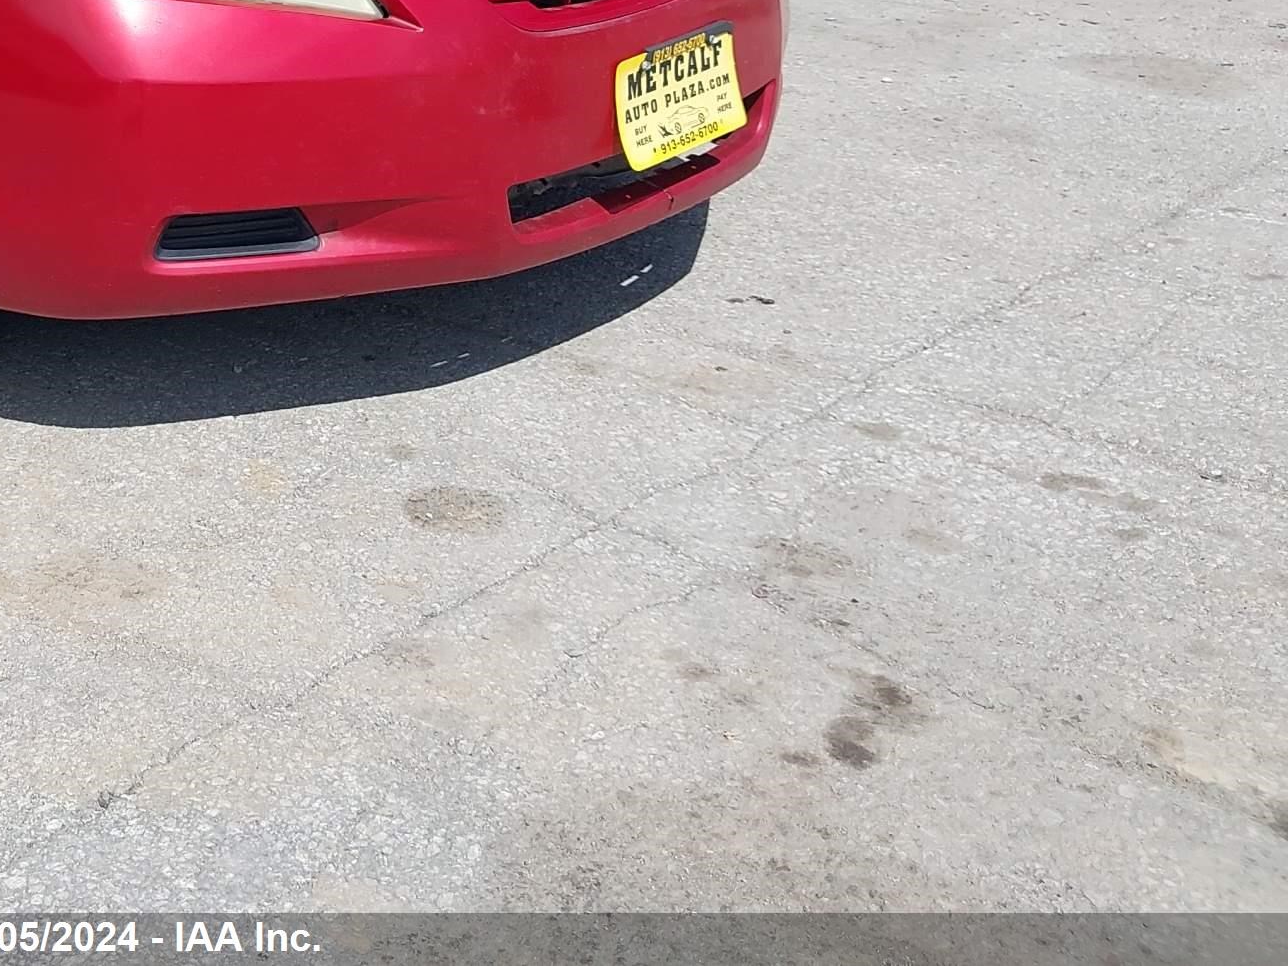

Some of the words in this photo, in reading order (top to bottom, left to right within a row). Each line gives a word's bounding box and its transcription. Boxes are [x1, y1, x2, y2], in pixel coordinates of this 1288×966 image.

[627, 39, 722, 101] METCALF
[625, 98, 658, 124] AUTO
[664, 73, 730, 108] PLAZA.COM
[716, 92, 728, 102] PAY
[717, 101, 732, 114] HERE
[634, 125, 648, 136] BUY
[635, 135, 653, 147] HERE
[660, 121, 719, 154] 913-652-6700
